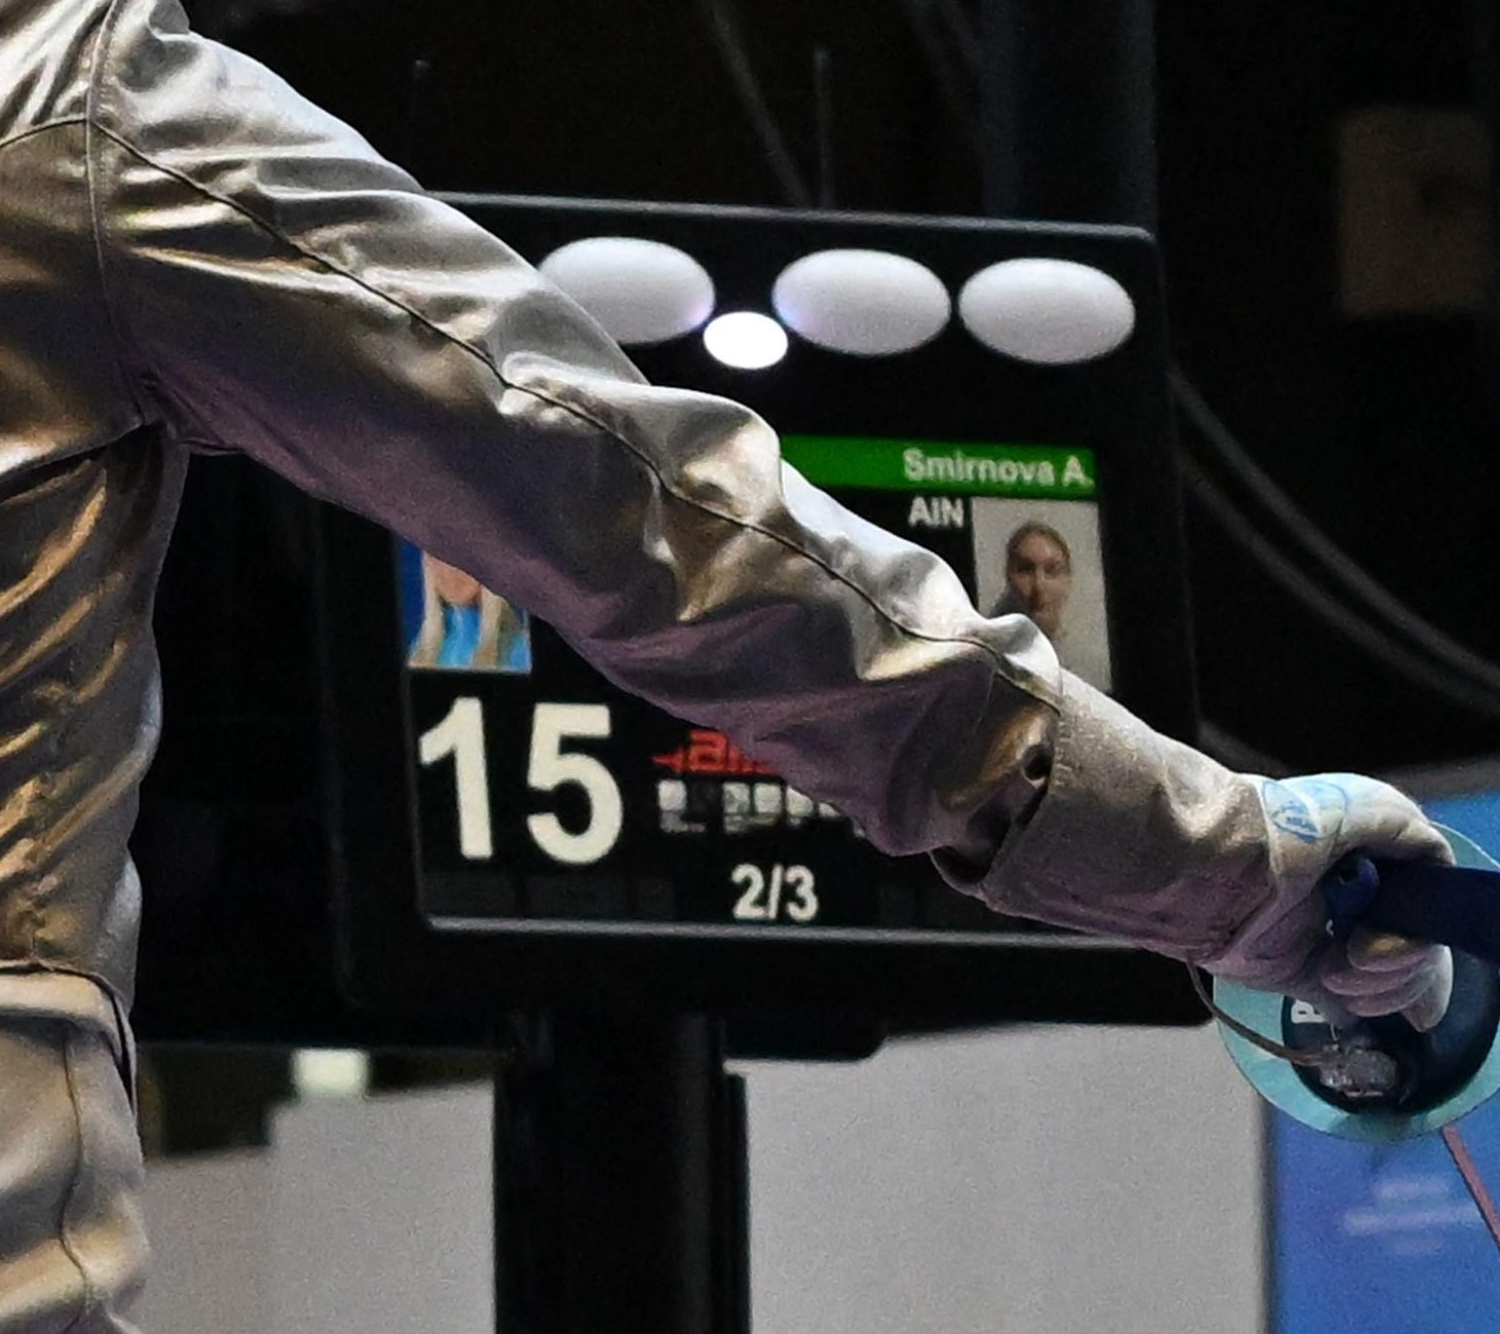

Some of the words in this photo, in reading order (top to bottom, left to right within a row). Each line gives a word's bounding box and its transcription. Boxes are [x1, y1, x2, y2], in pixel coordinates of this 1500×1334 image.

[902, 447, 1055, 487] Smirnova
[908, 496, 965, 528] AIN
[419, 696, 624, 865] 15
[731, 864, 819, 921] 2/3
